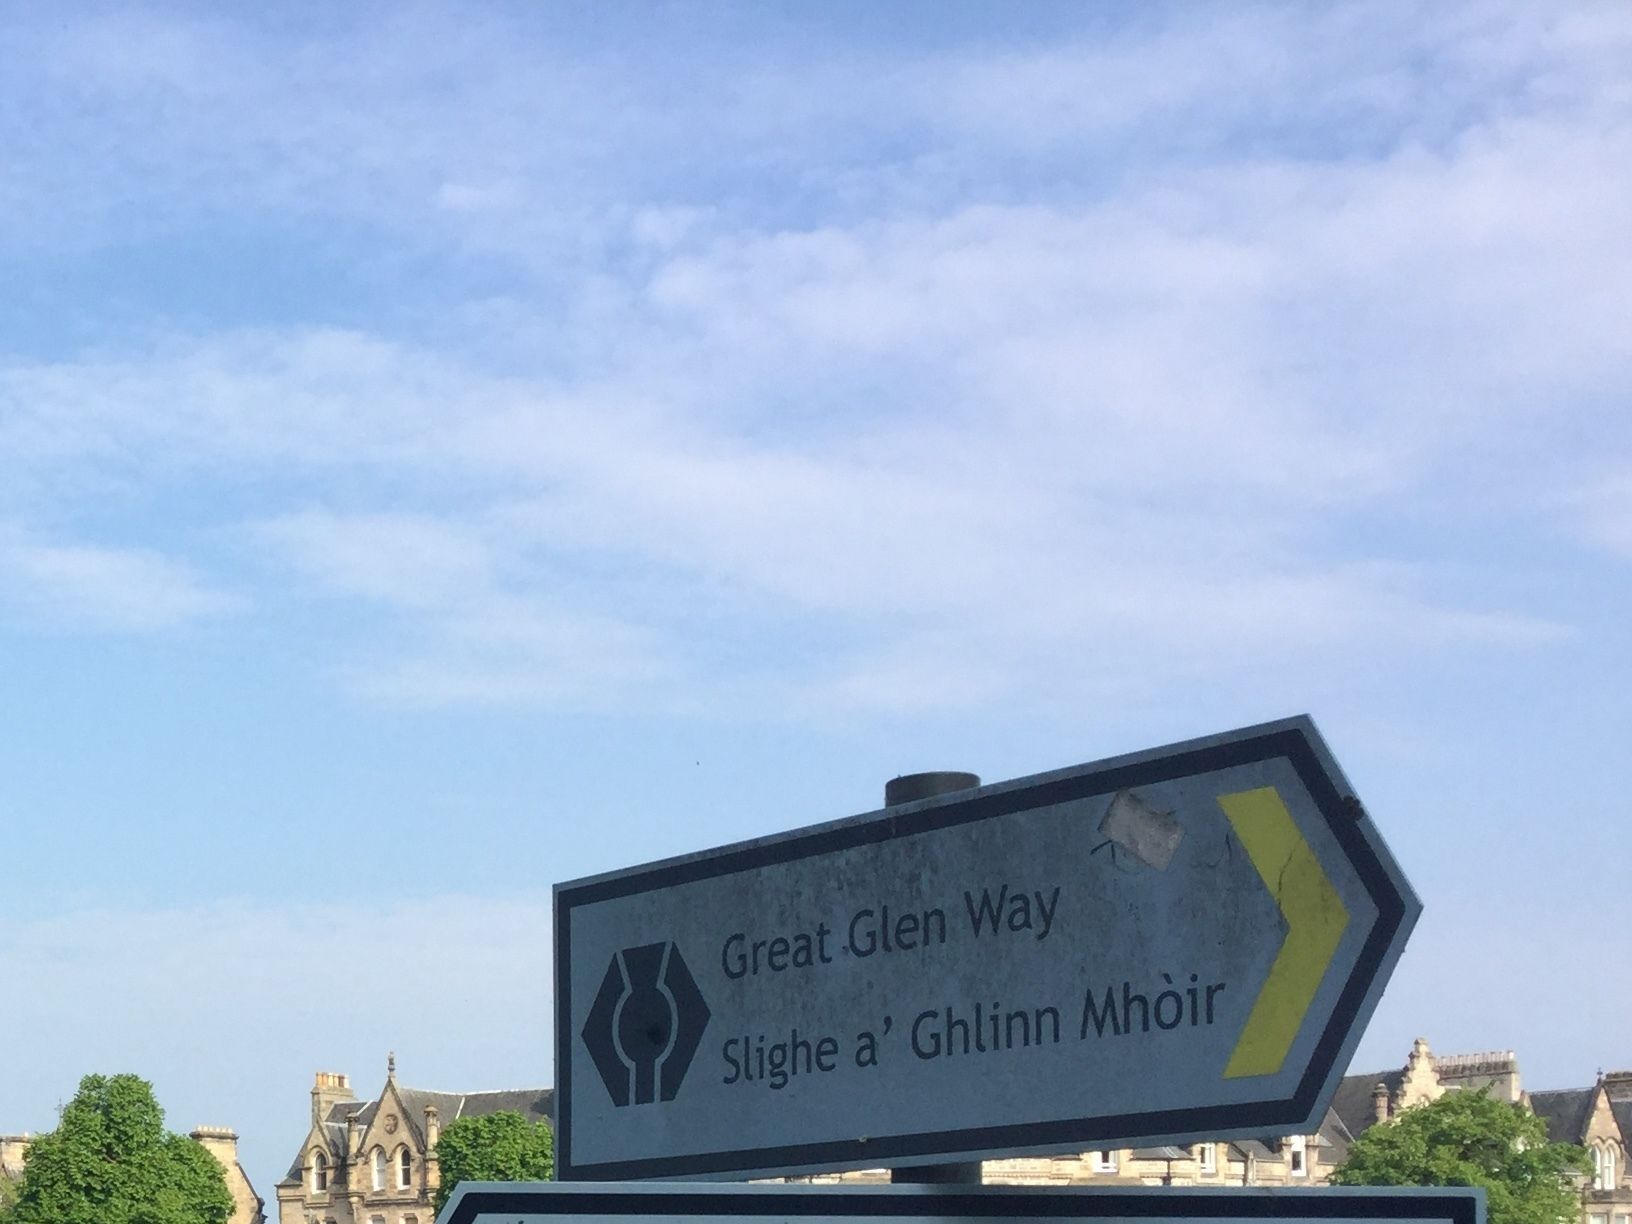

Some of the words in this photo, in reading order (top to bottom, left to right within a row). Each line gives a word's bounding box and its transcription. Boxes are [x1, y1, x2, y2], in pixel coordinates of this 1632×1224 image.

[720, 922, 834, 982] Great
[848, 904, 948, 958] Glen
[963, 883, 1062, 941] Way
[722, 1028, 840, 1090] Slighe
[911, 1001, 1060, 1060] Ghlinn
[1080, 972, 1228, 1041] Mhòir
